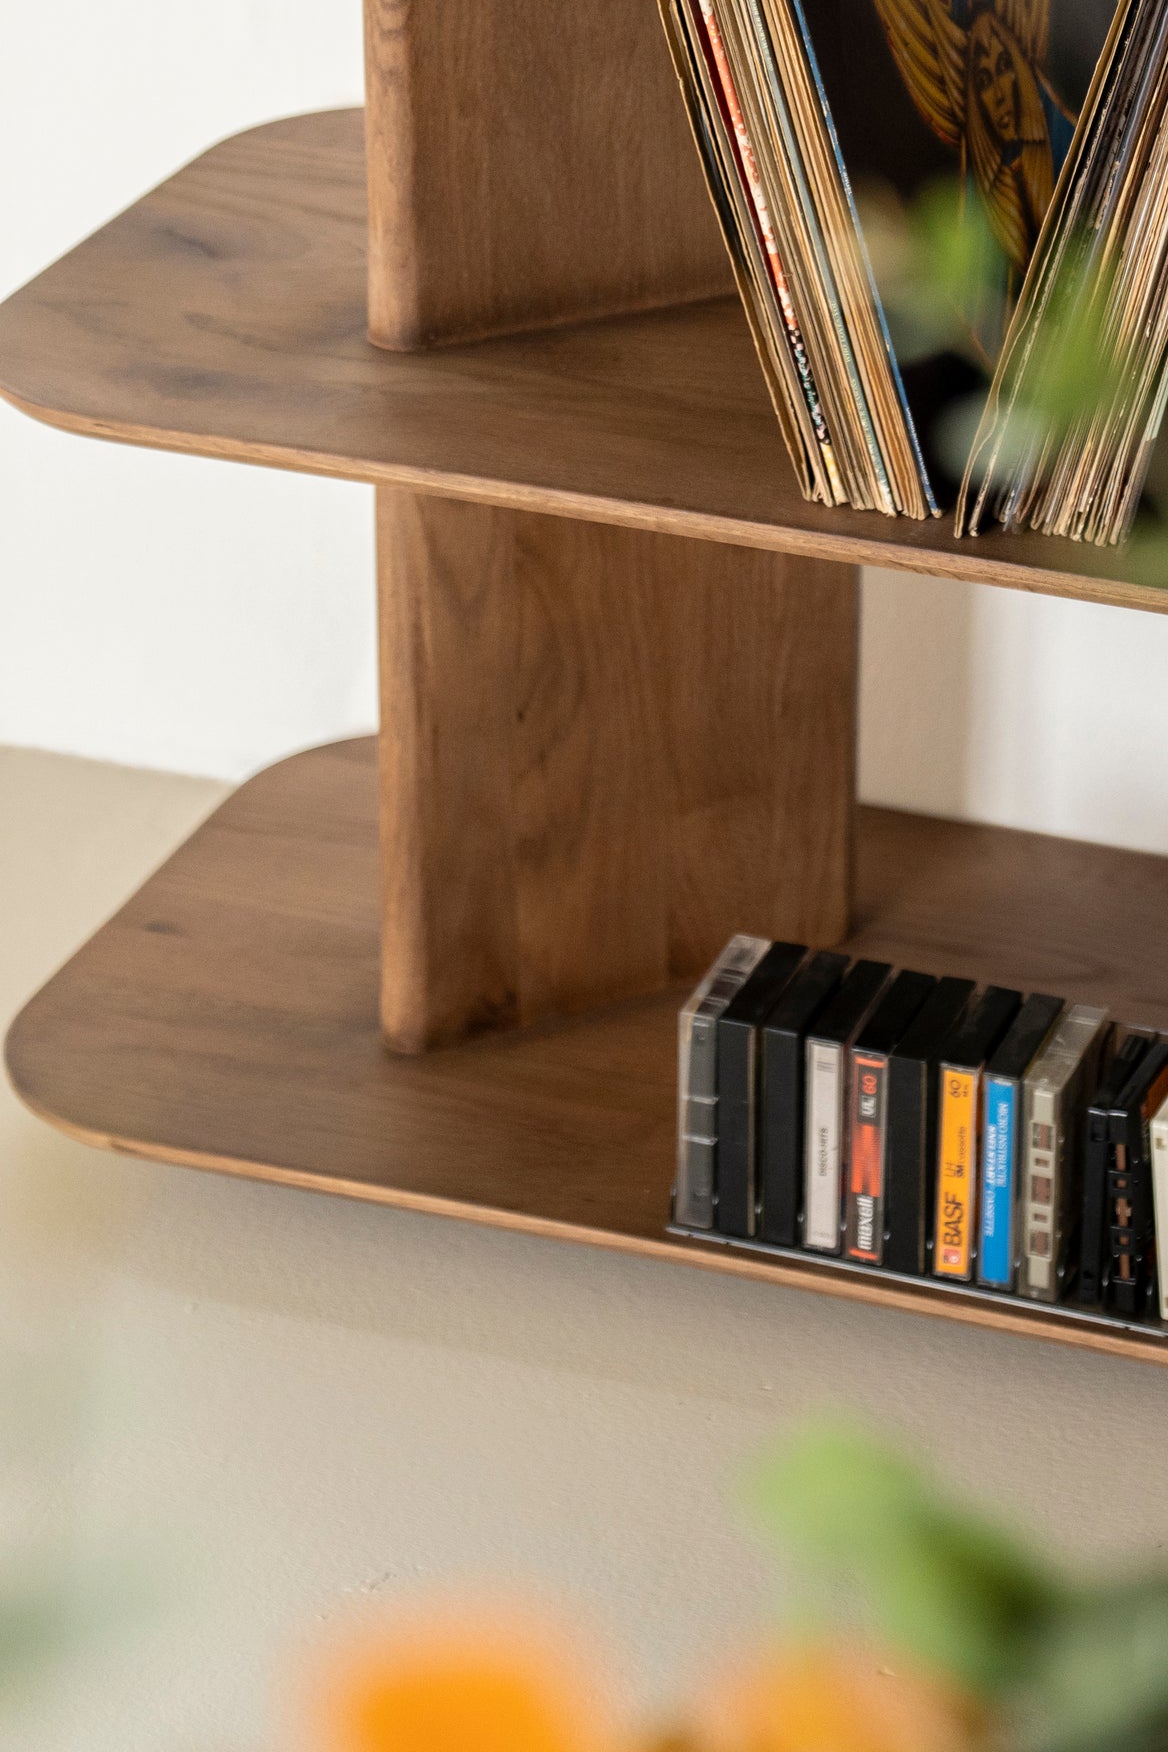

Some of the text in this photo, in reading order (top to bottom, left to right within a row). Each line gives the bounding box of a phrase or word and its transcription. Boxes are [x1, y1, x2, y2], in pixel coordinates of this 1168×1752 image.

[863, 1074, 877, 1094] 60
[949, 1078, 963, 1098] 60
[856, 1196, 874, 1251] maxell
[942, 1192, 964, 1247] BASF
